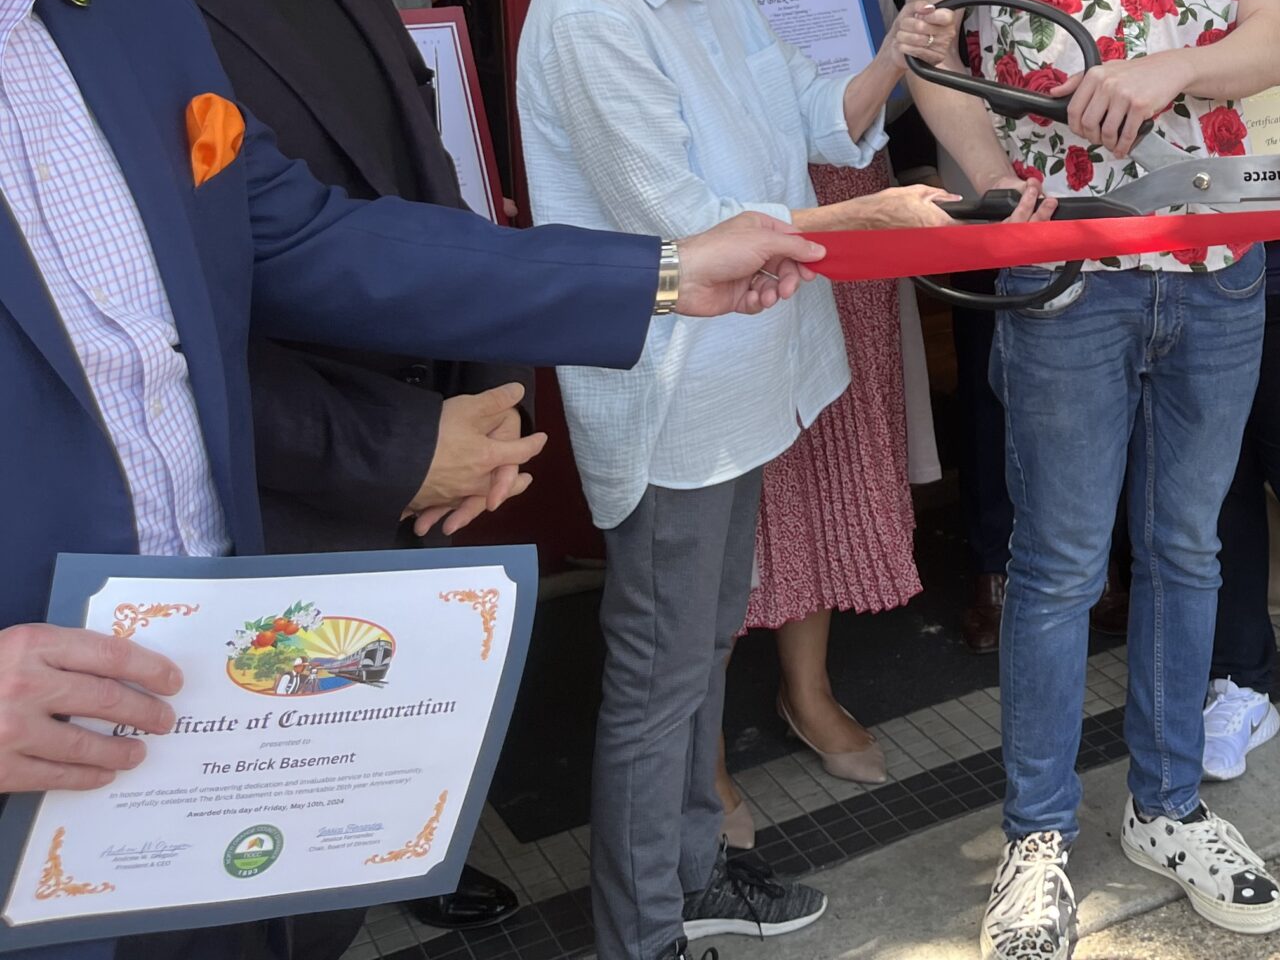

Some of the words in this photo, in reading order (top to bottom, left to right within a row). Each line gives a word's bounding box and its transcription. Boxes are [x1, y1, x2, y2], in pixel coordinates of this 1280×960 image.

[1265, 137, 1278, 146] The
[112, 714, 238, 737] Ceficate
[246, 712, 273, 729] of
[278, 698, 456, 728] Commemoration
[260, 739, 301, 749] presented
[202, 762, 231, 774] The
[235, 758, 276, 773] Brick
[280, 752, 356, 769] Basement
[156, 787, 187, 796] decades
[199, 784, 242, 792] unwavering
[244, 781, 283, 789] dedication
[128, 799, 158, 809] joyfully
[160, 797, 197, 806] celebrate
[214, 793, 234, 801] Brick
[235, 791, 272, 800] Basement
[186, 810, 221, 818] Awarded
